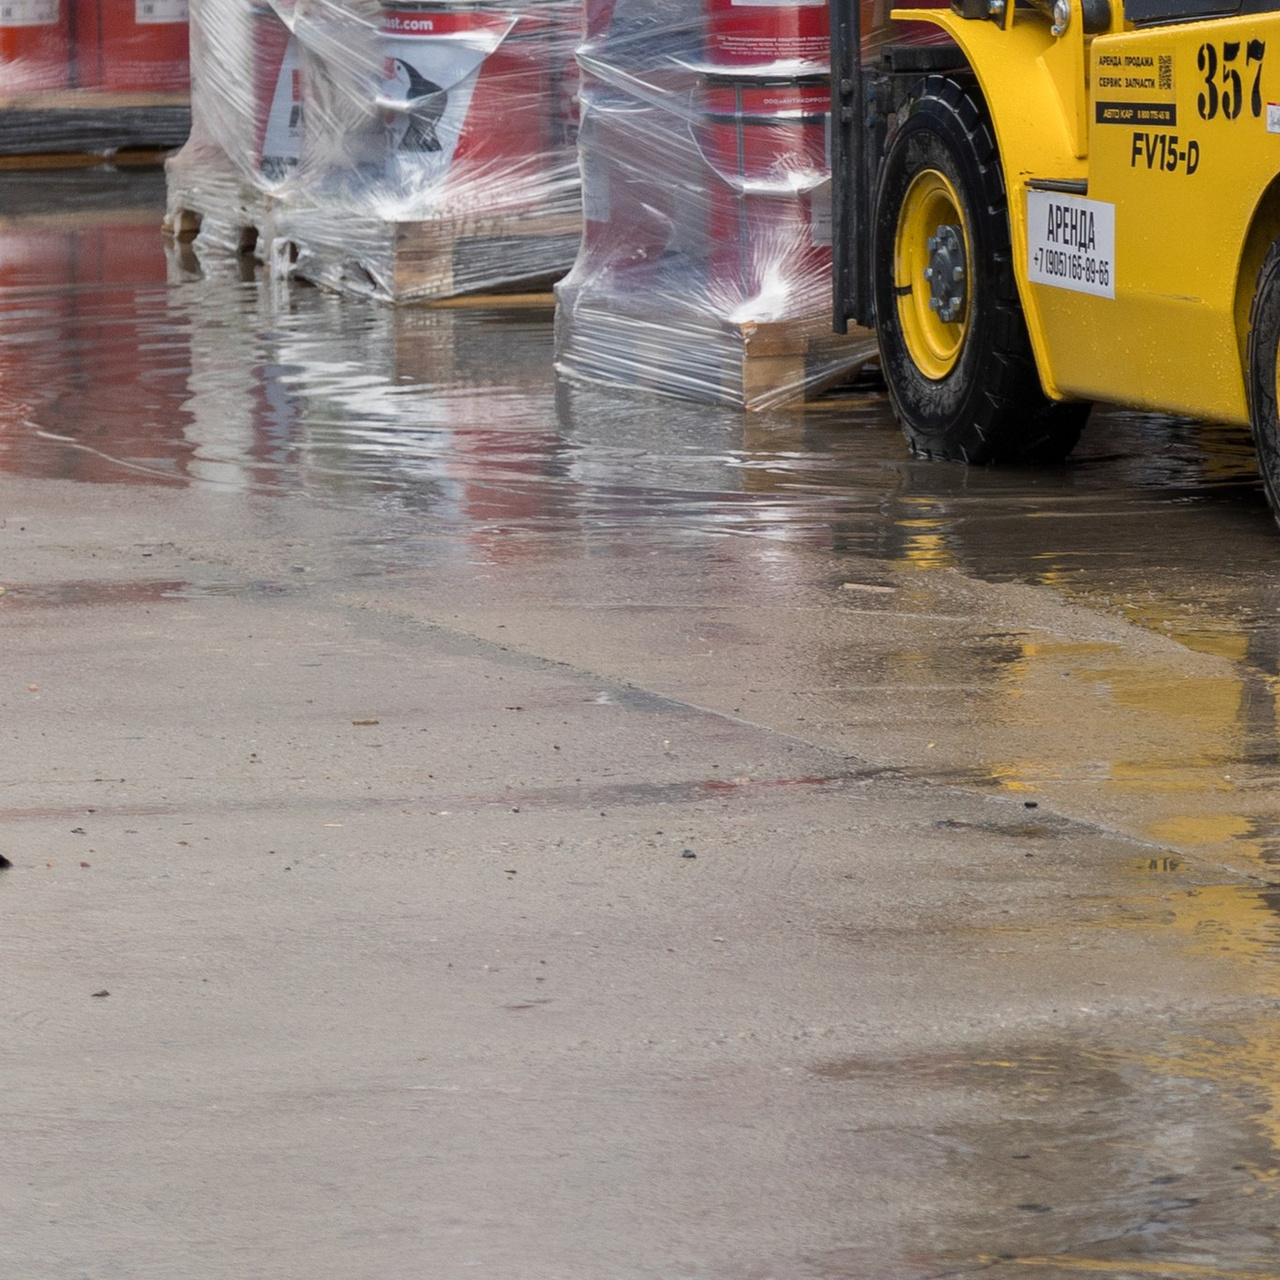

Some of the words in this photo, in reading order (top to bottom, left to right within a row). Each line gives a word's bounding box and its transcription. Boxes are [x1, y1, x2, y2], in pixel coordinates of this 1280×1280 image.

[1098, 55, 1122, 67] АРЕНДА
[1124, 56, 1154, 68] ПРОДАЖА
[1197, 39, 1266, 121] 357
[1098, 77, 1122, 88] СЕРВИС
[1124, 77, 1155, 89] ЗАПЧАСТИ
[1120, 109, 1133, 120] КАР
[1131, 132, 1200, 176] FV15-D
[1046, 203, 1096, 254] АРЕНДА
[1033, 247, 1044, 273] +7
[1045, 249, 1067, 278] (905)
[1068, 253, 1110, 287] 165-89-65
